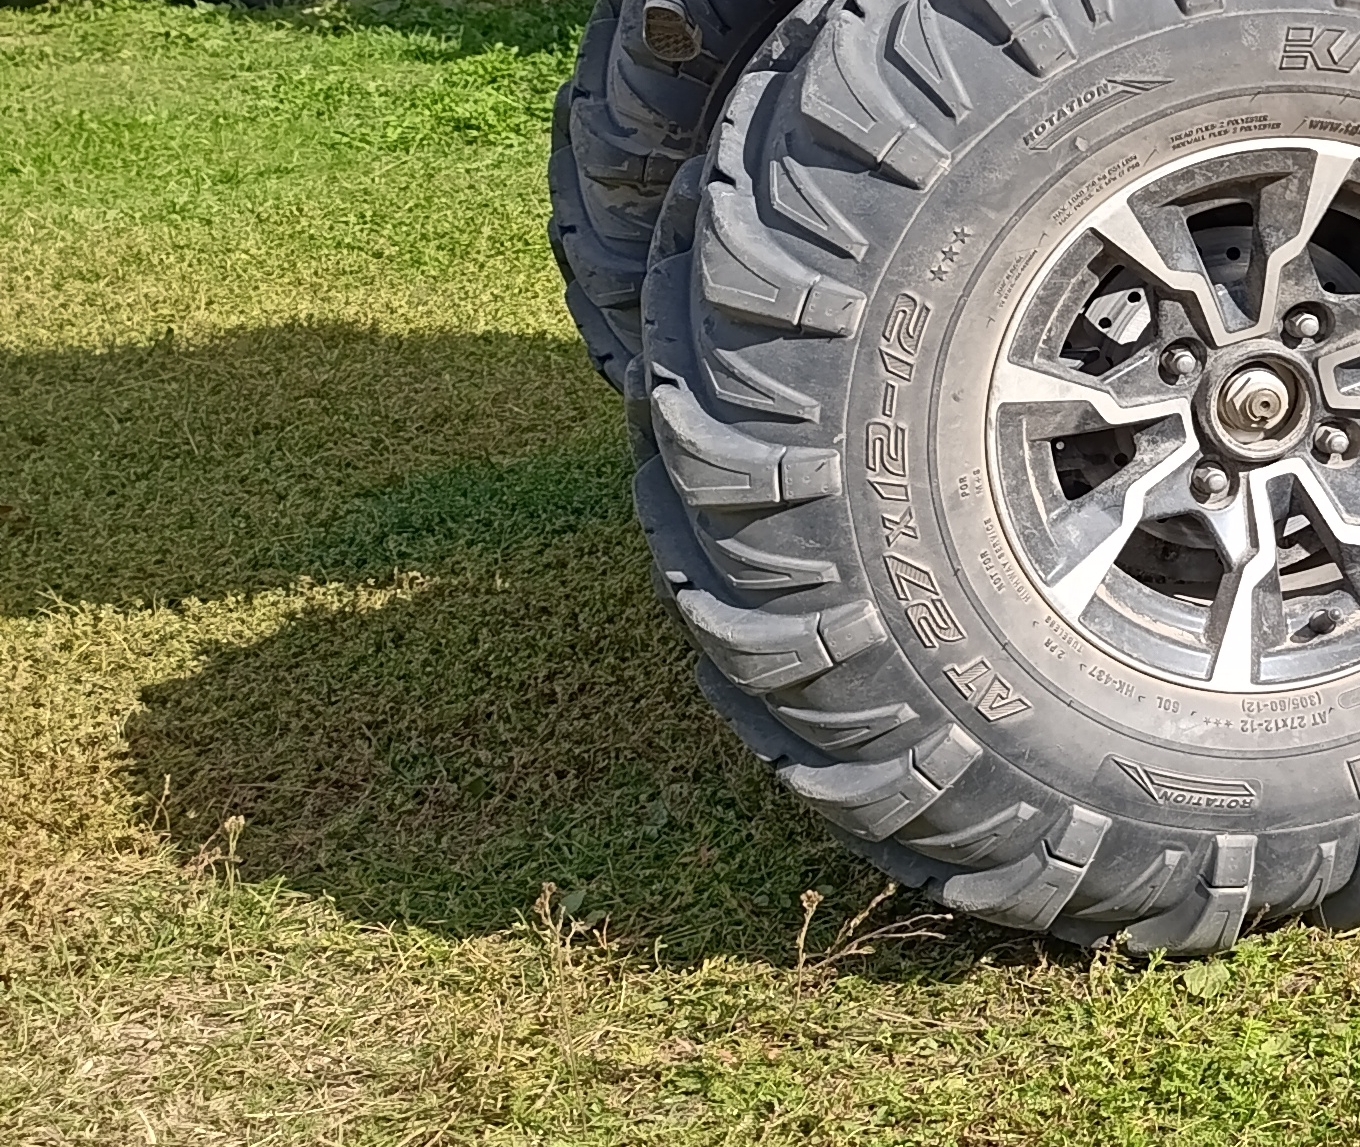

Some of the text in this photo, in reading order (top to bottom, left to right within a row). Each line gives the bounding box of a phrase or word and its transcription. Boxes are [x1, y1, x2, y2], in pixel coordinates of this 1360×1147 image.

[1023, 82, 1112, 147] ROTATION
[958, 475, 970, 499] POR
[866, 290, 1033, 724] AT 27x12-12
[983, 517, 1003, 560] SERVICE
[979, 550, 1006, 593] NOT FOR
[1044, 615, 1084, 654] TUBELESS
[1241, 691, 1323, 714] (305/60-12)
[1239, 711, 1328, 734] AT 27x12-12
[1158, 789, 1255, 809] ROTATION
